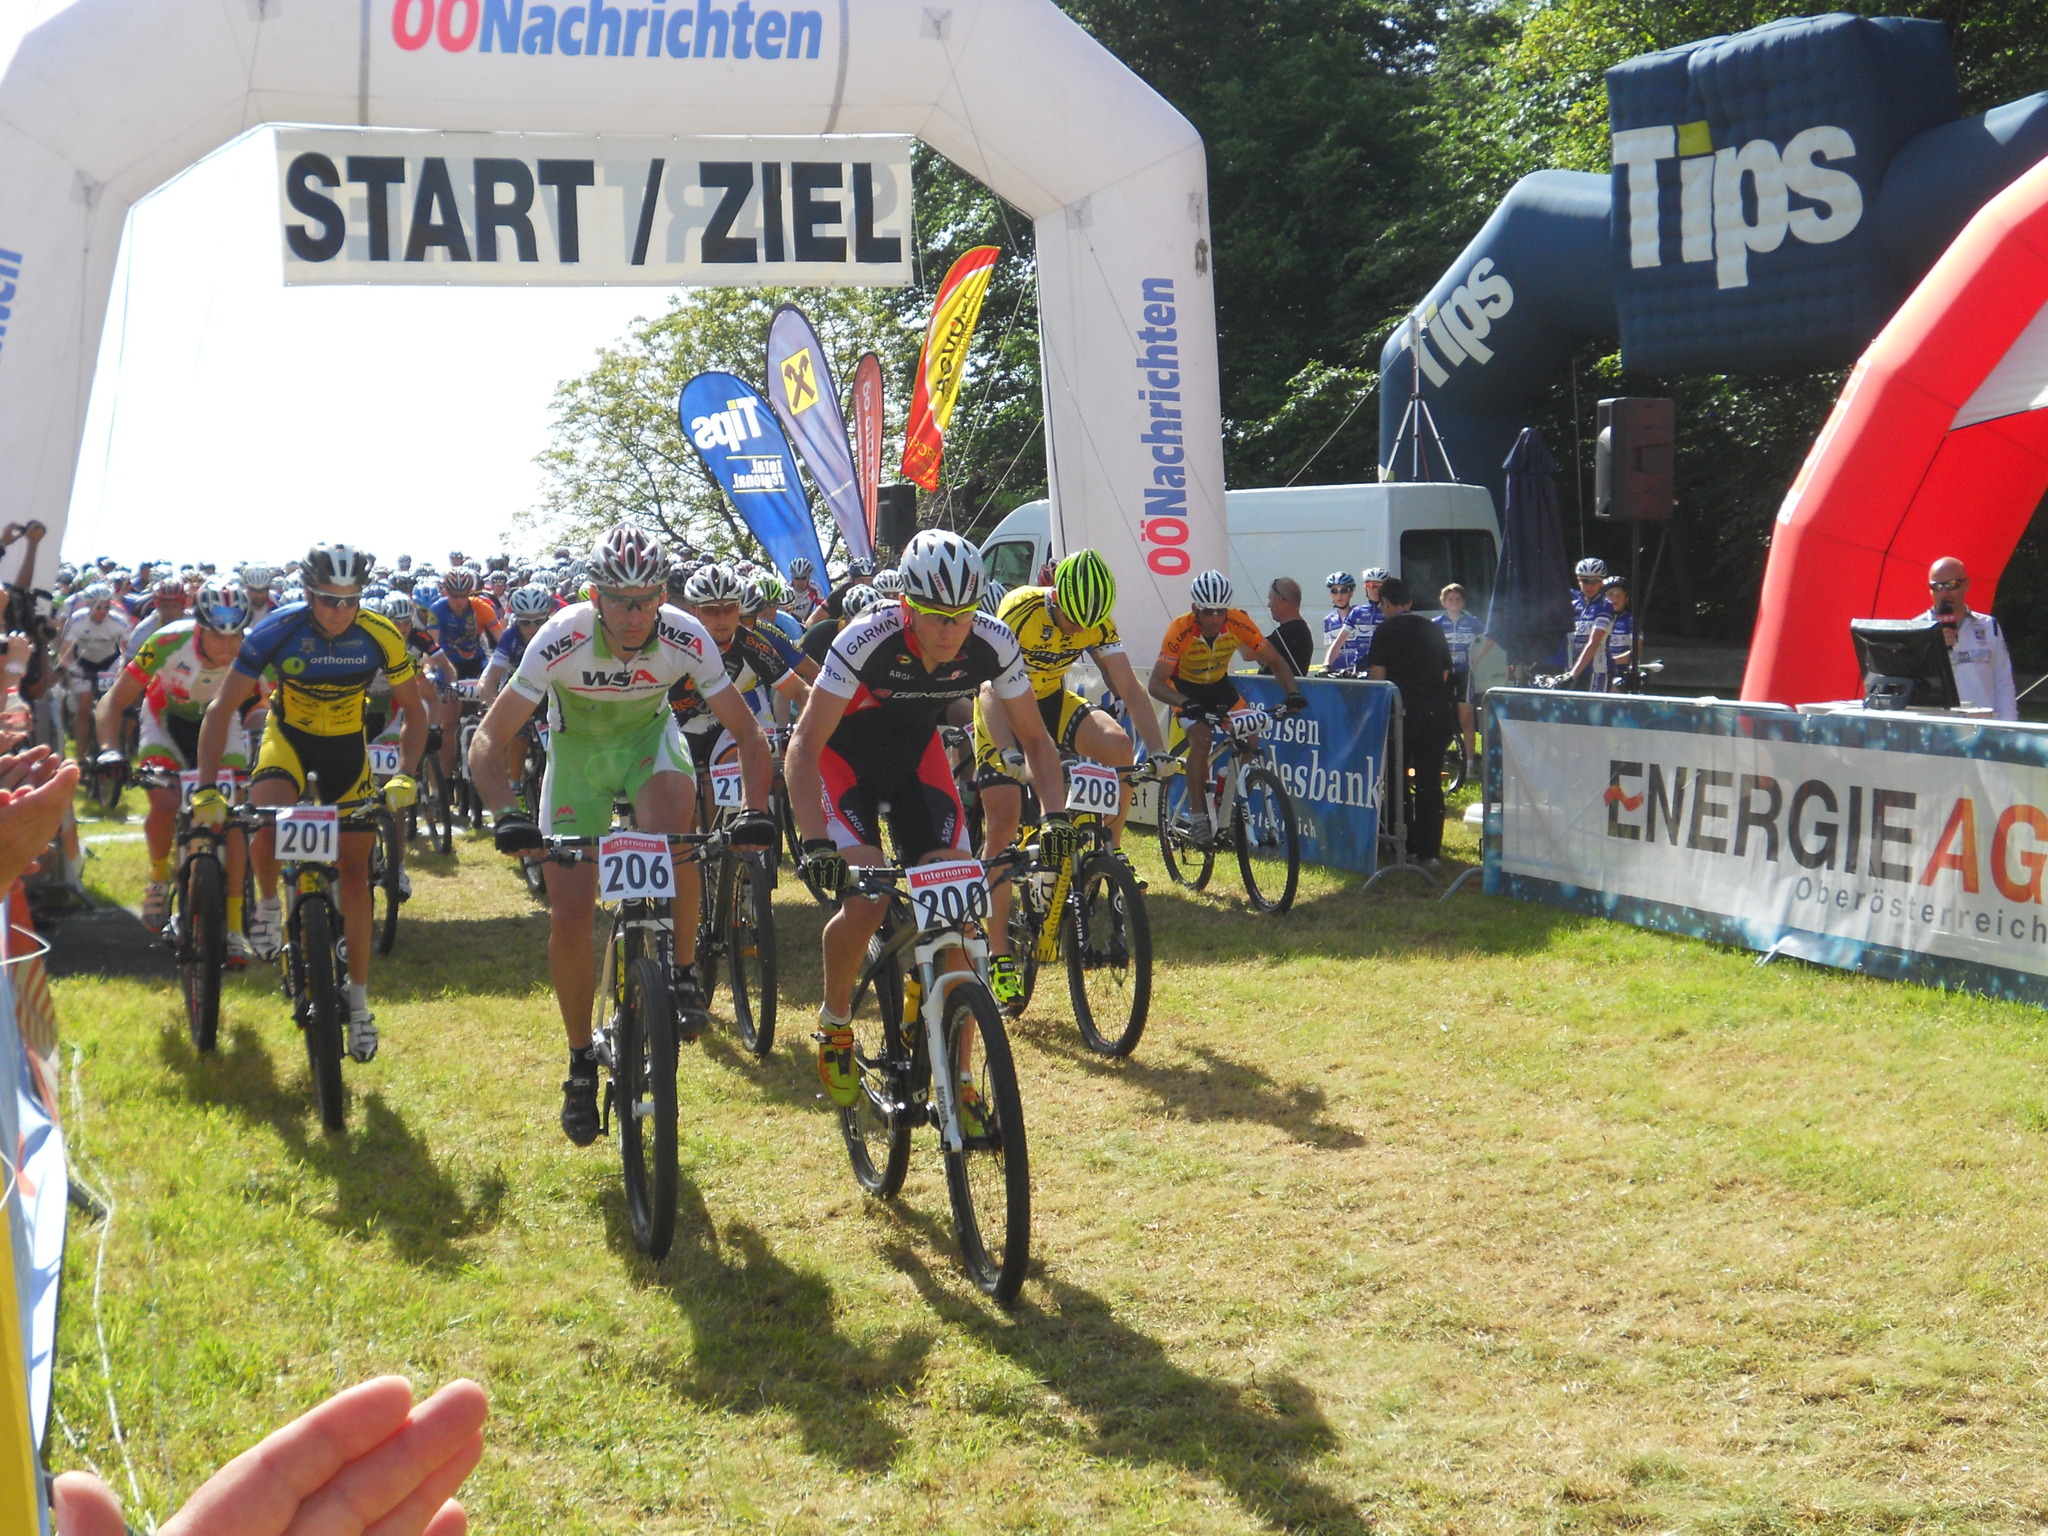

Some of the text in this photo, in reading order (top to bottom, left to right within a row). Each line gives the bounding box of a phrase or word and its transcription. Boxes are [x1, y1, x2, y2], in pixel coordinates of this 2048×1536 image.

[285, 152, 595, 265] START
[700, 160, 902, 264] ZIEL
[1613, 120, 1864, 290] Tips
[1401, 257, 1514, 388] Tips
[539, 630, 586, 661] WSA
[658, 621, 703, 656] WSA
[846, 616, 900, 656] GARMIN
[309, 655, 367, 665] orthomol
[581, 669, 659, 687] WSA
[1234, 712, 1267, 735] 209
[1072, 776, 1117, 808] 208
[281, 821, 331, 854] 201
[603, 853, 669, 893] 206
[919, 867, 972, 882] Internorm
[918, 881, 988, 930] 200
[1795, 876, 2048, 944] Oberösterreich
